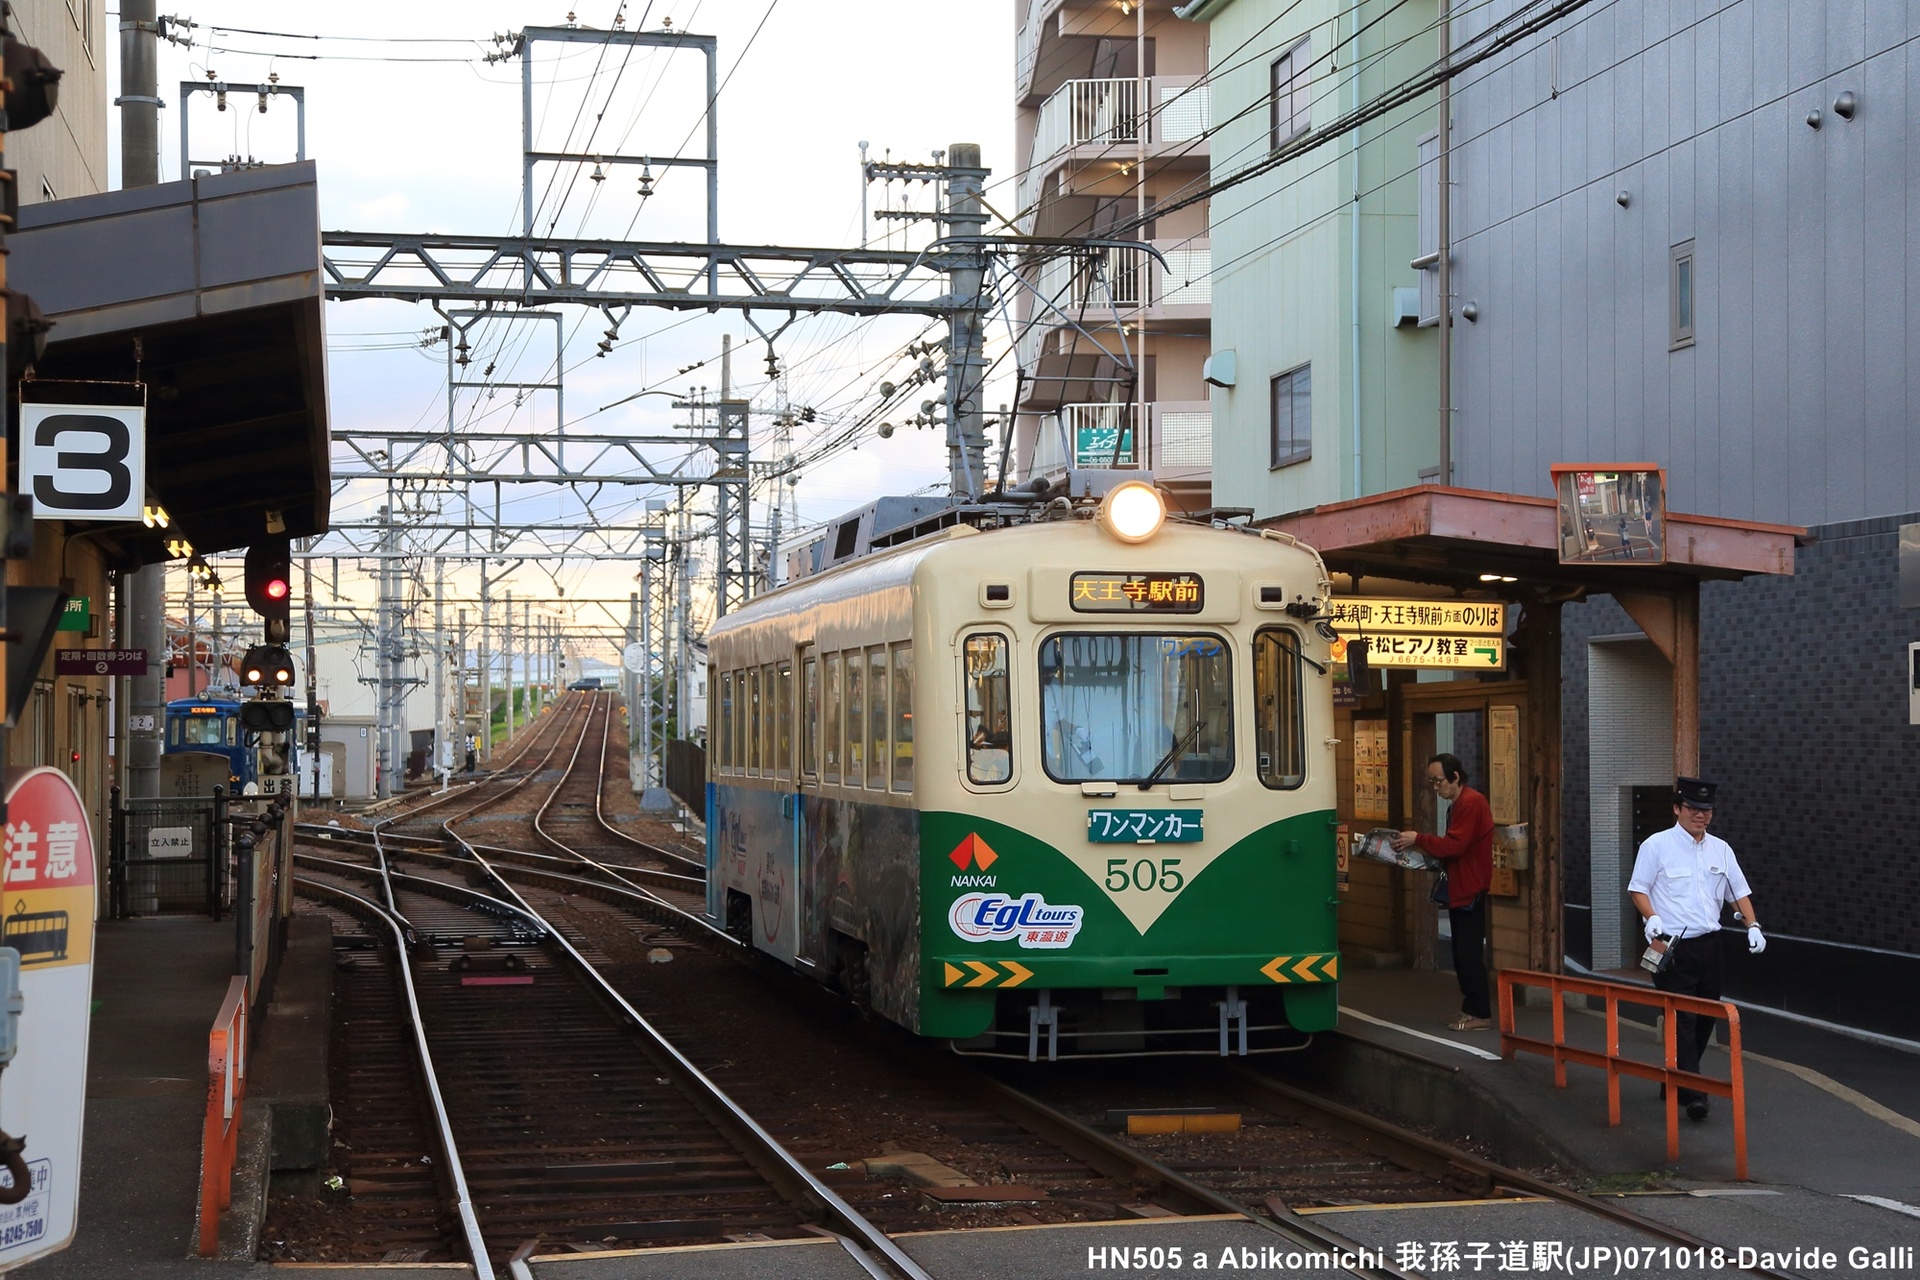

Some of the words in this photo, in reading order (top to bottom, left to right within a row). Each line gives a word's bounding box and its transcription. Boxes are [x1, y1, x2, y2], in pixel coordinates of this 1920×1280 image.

[33, 414, 131, 510] 3
[1073, 580, 1198, 602] 天王寺駅前
[61, 651, 143, 661] 定期・回数券うりば
[1164, 640, 1220, 656] ワンマン
[1398, 656, 1460, 664] 6675-1498
[1092, 812, 1199, 838] ワンマンカー
[151, 837, 190, 847] 立入禁止
[3, 820, 79, 884] 注意
[950, 875, 997, 887] NANKAI
[1105, 859, 1184, 893] 505
[1035, 908, 1078, 921] tours
